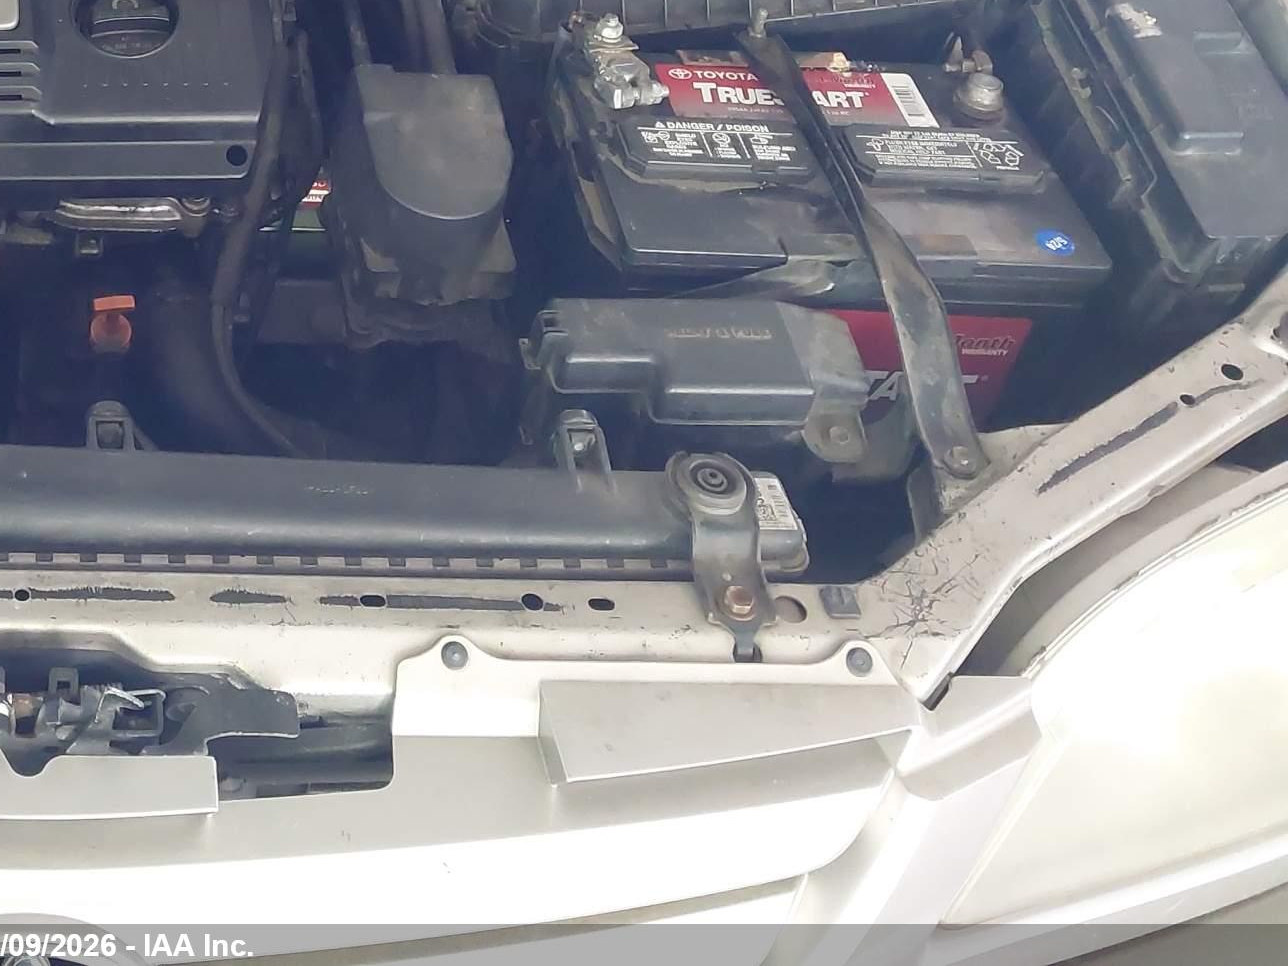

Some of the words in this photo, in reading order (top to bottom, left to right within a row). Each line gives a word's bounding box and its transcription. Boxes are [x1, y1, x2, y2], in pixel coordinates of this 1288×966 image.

[692, 69, 758, 82] TOYOTA
[666, 121, 714, 131] DANGER
[726, 124, 770, 134] POISON
